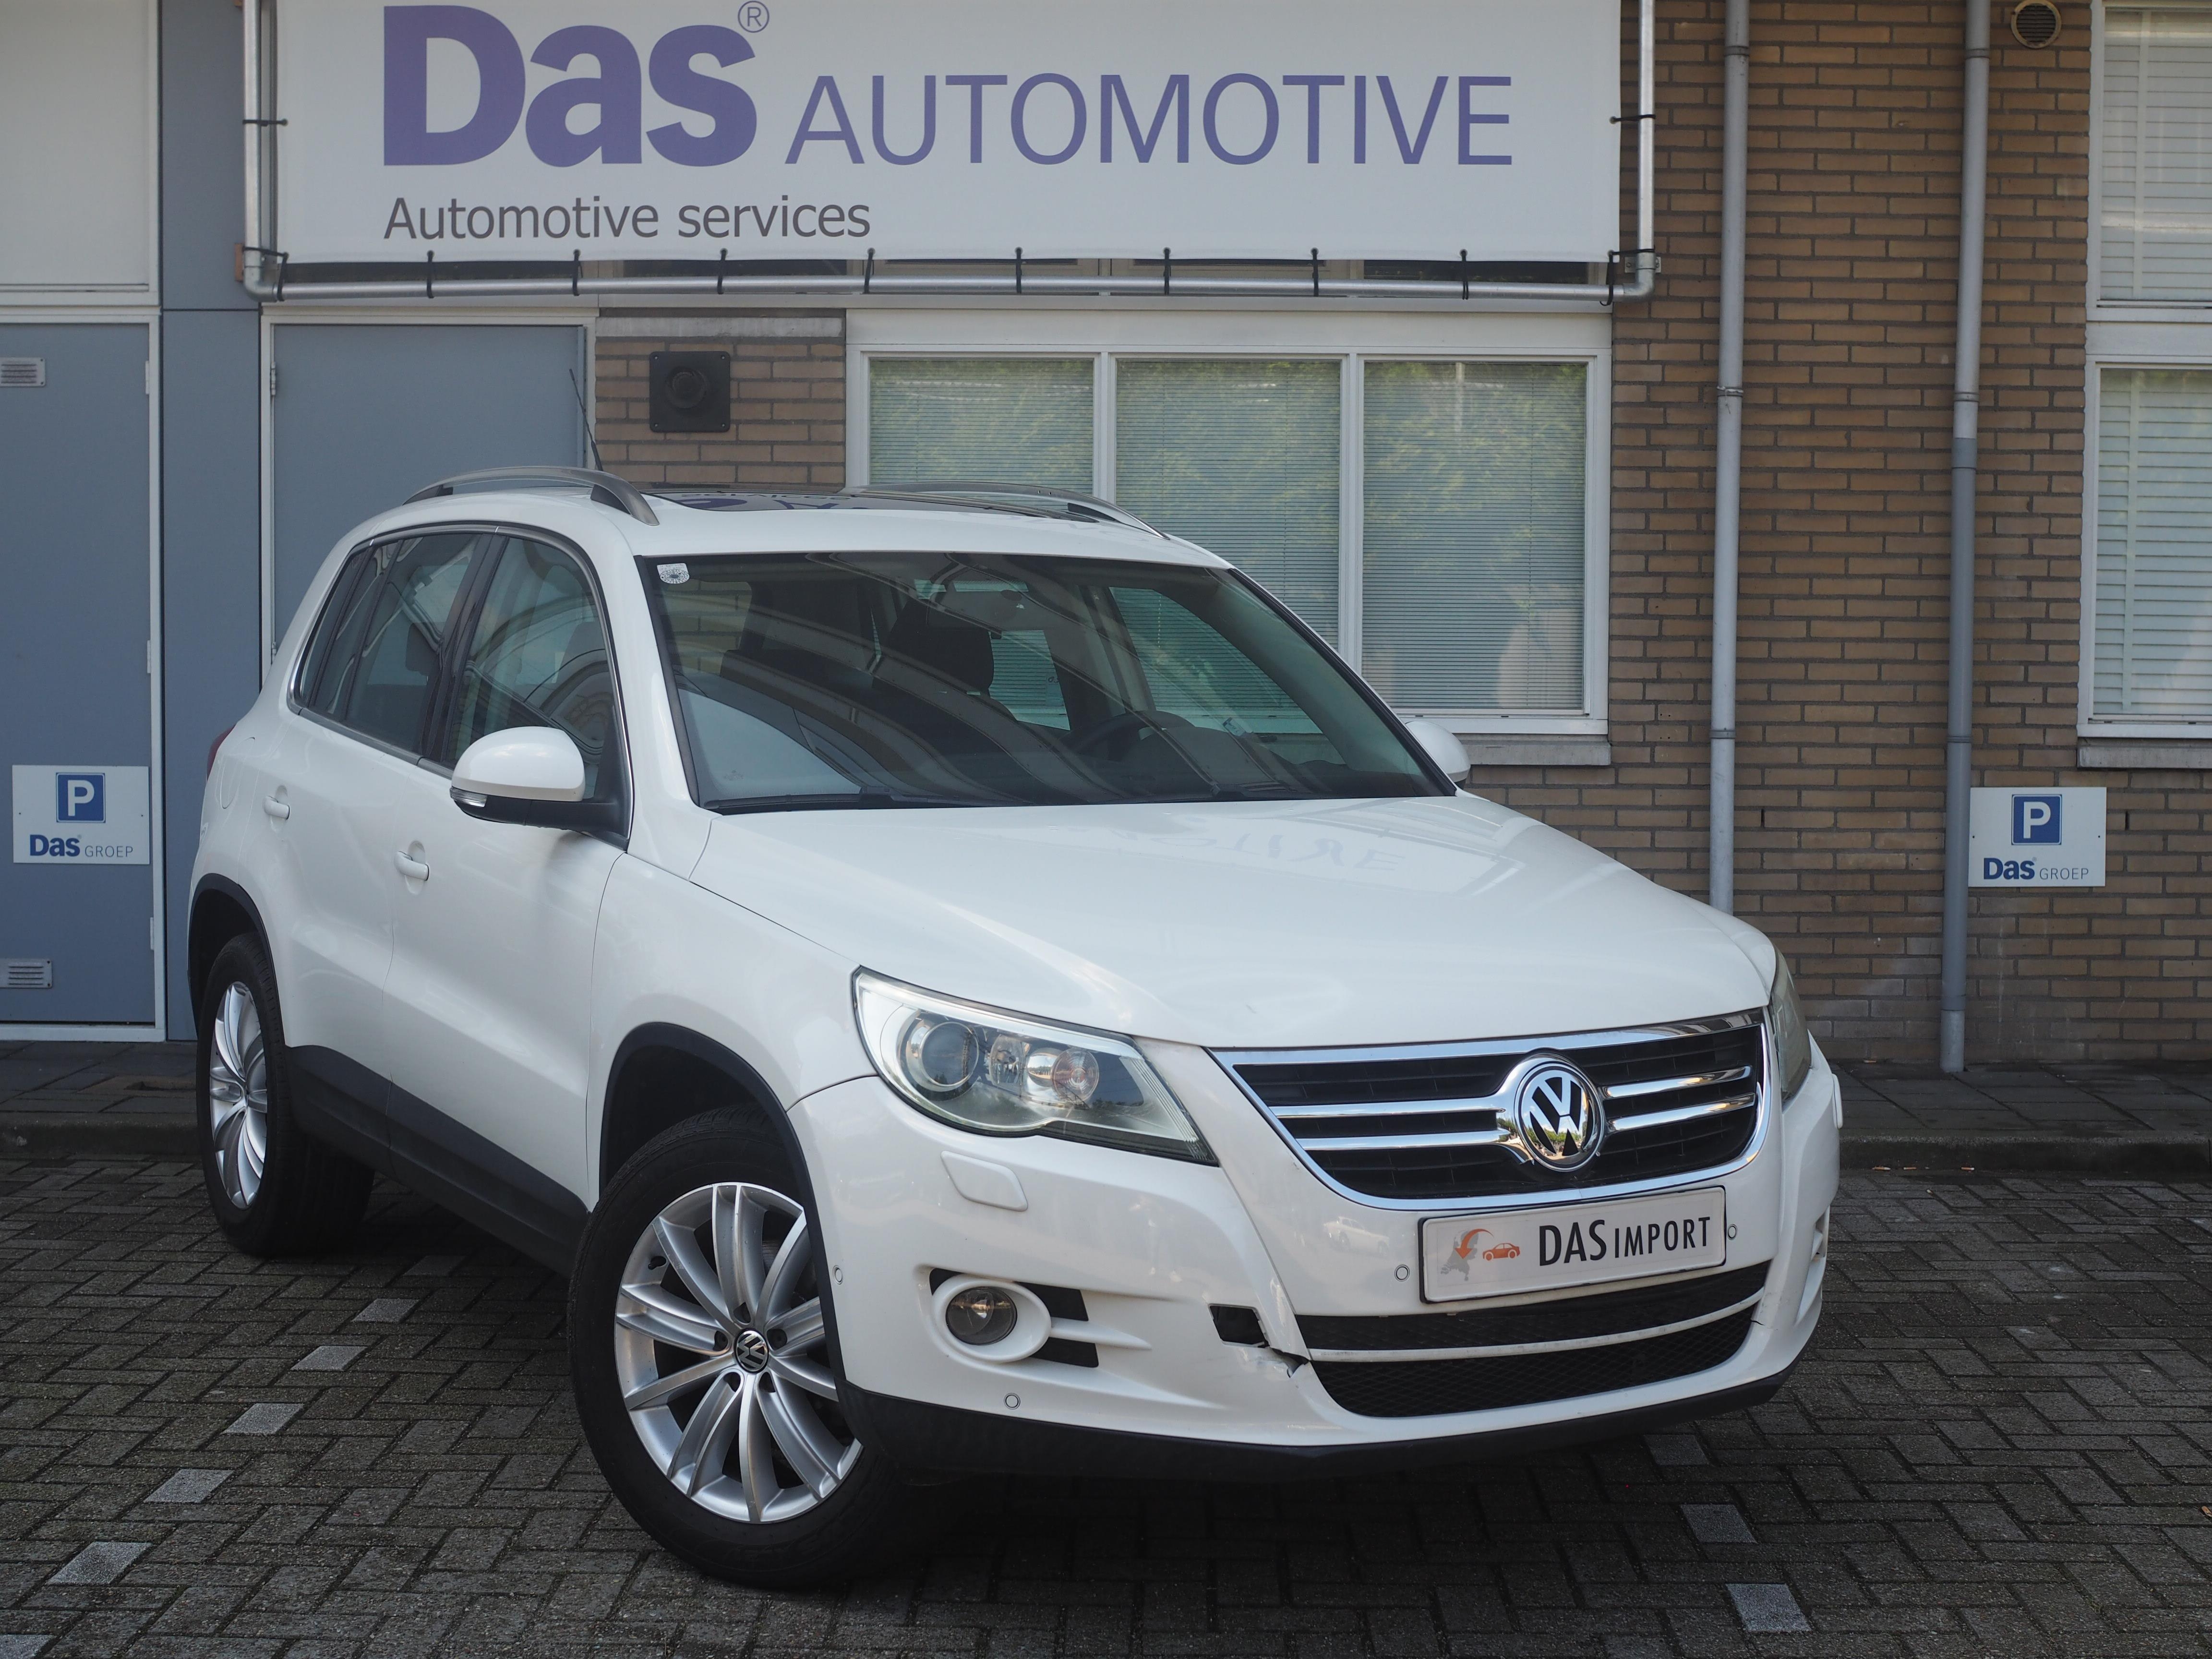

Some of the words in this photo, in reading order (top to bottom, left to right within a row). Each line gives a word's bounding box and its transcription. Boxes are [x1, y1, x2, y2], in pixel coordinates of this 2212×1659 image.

[785, 74, 1512, 166] AUTOMOTIVE
[384, 195, 658, 239] Automotive
[678, 195, 871, 238] services
[84, 845, 133, 858] GROEP
[2039, 867, 2089, 880] GROEP
[1539, 1220, 1607, 1266] DAS
[1614, 1216, 1711, 1258] IMPORT
